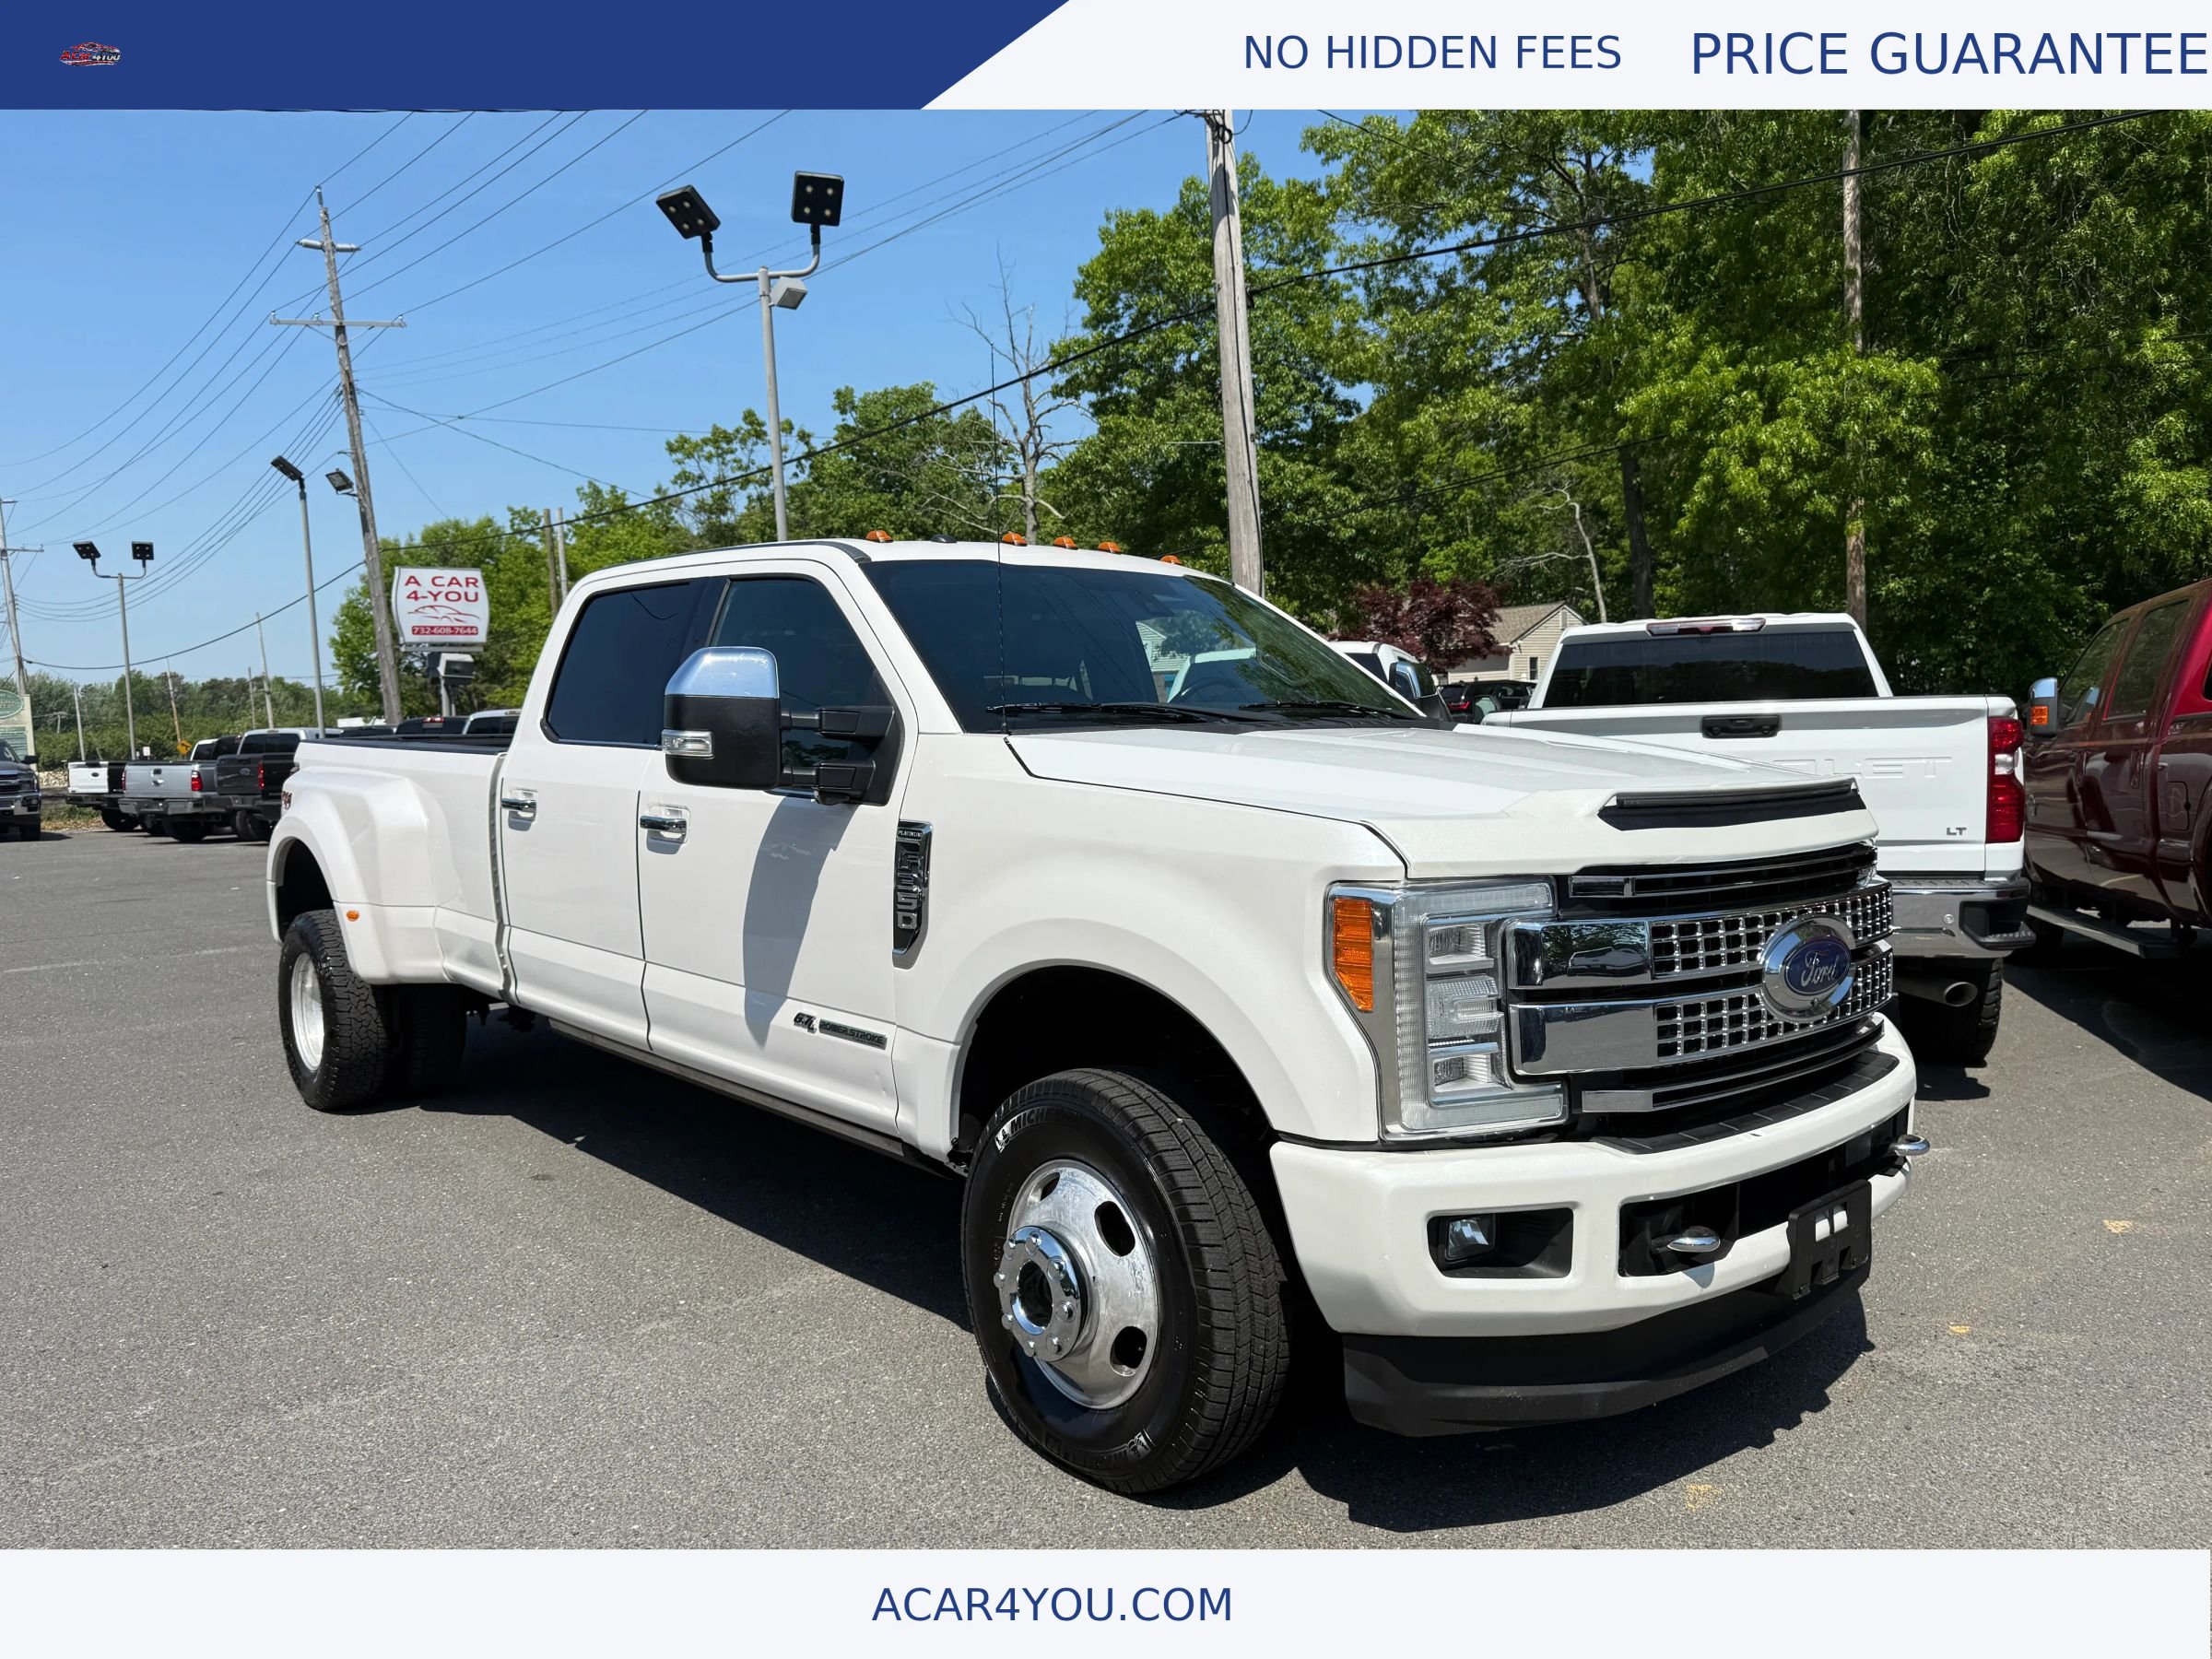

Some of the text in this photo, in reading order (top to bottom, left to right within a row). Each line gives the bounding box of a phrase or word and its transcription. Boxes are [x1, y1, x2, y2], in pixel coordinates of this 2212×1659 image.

[405, 575, 478, 588] A CAR
[406, 590, 478, 603] 4-YOU
[412, 627, 477, 635] 732-608-7644
[1946, 827, 1967, 836] LT
[1800, 949, 1840, 987] Ford
